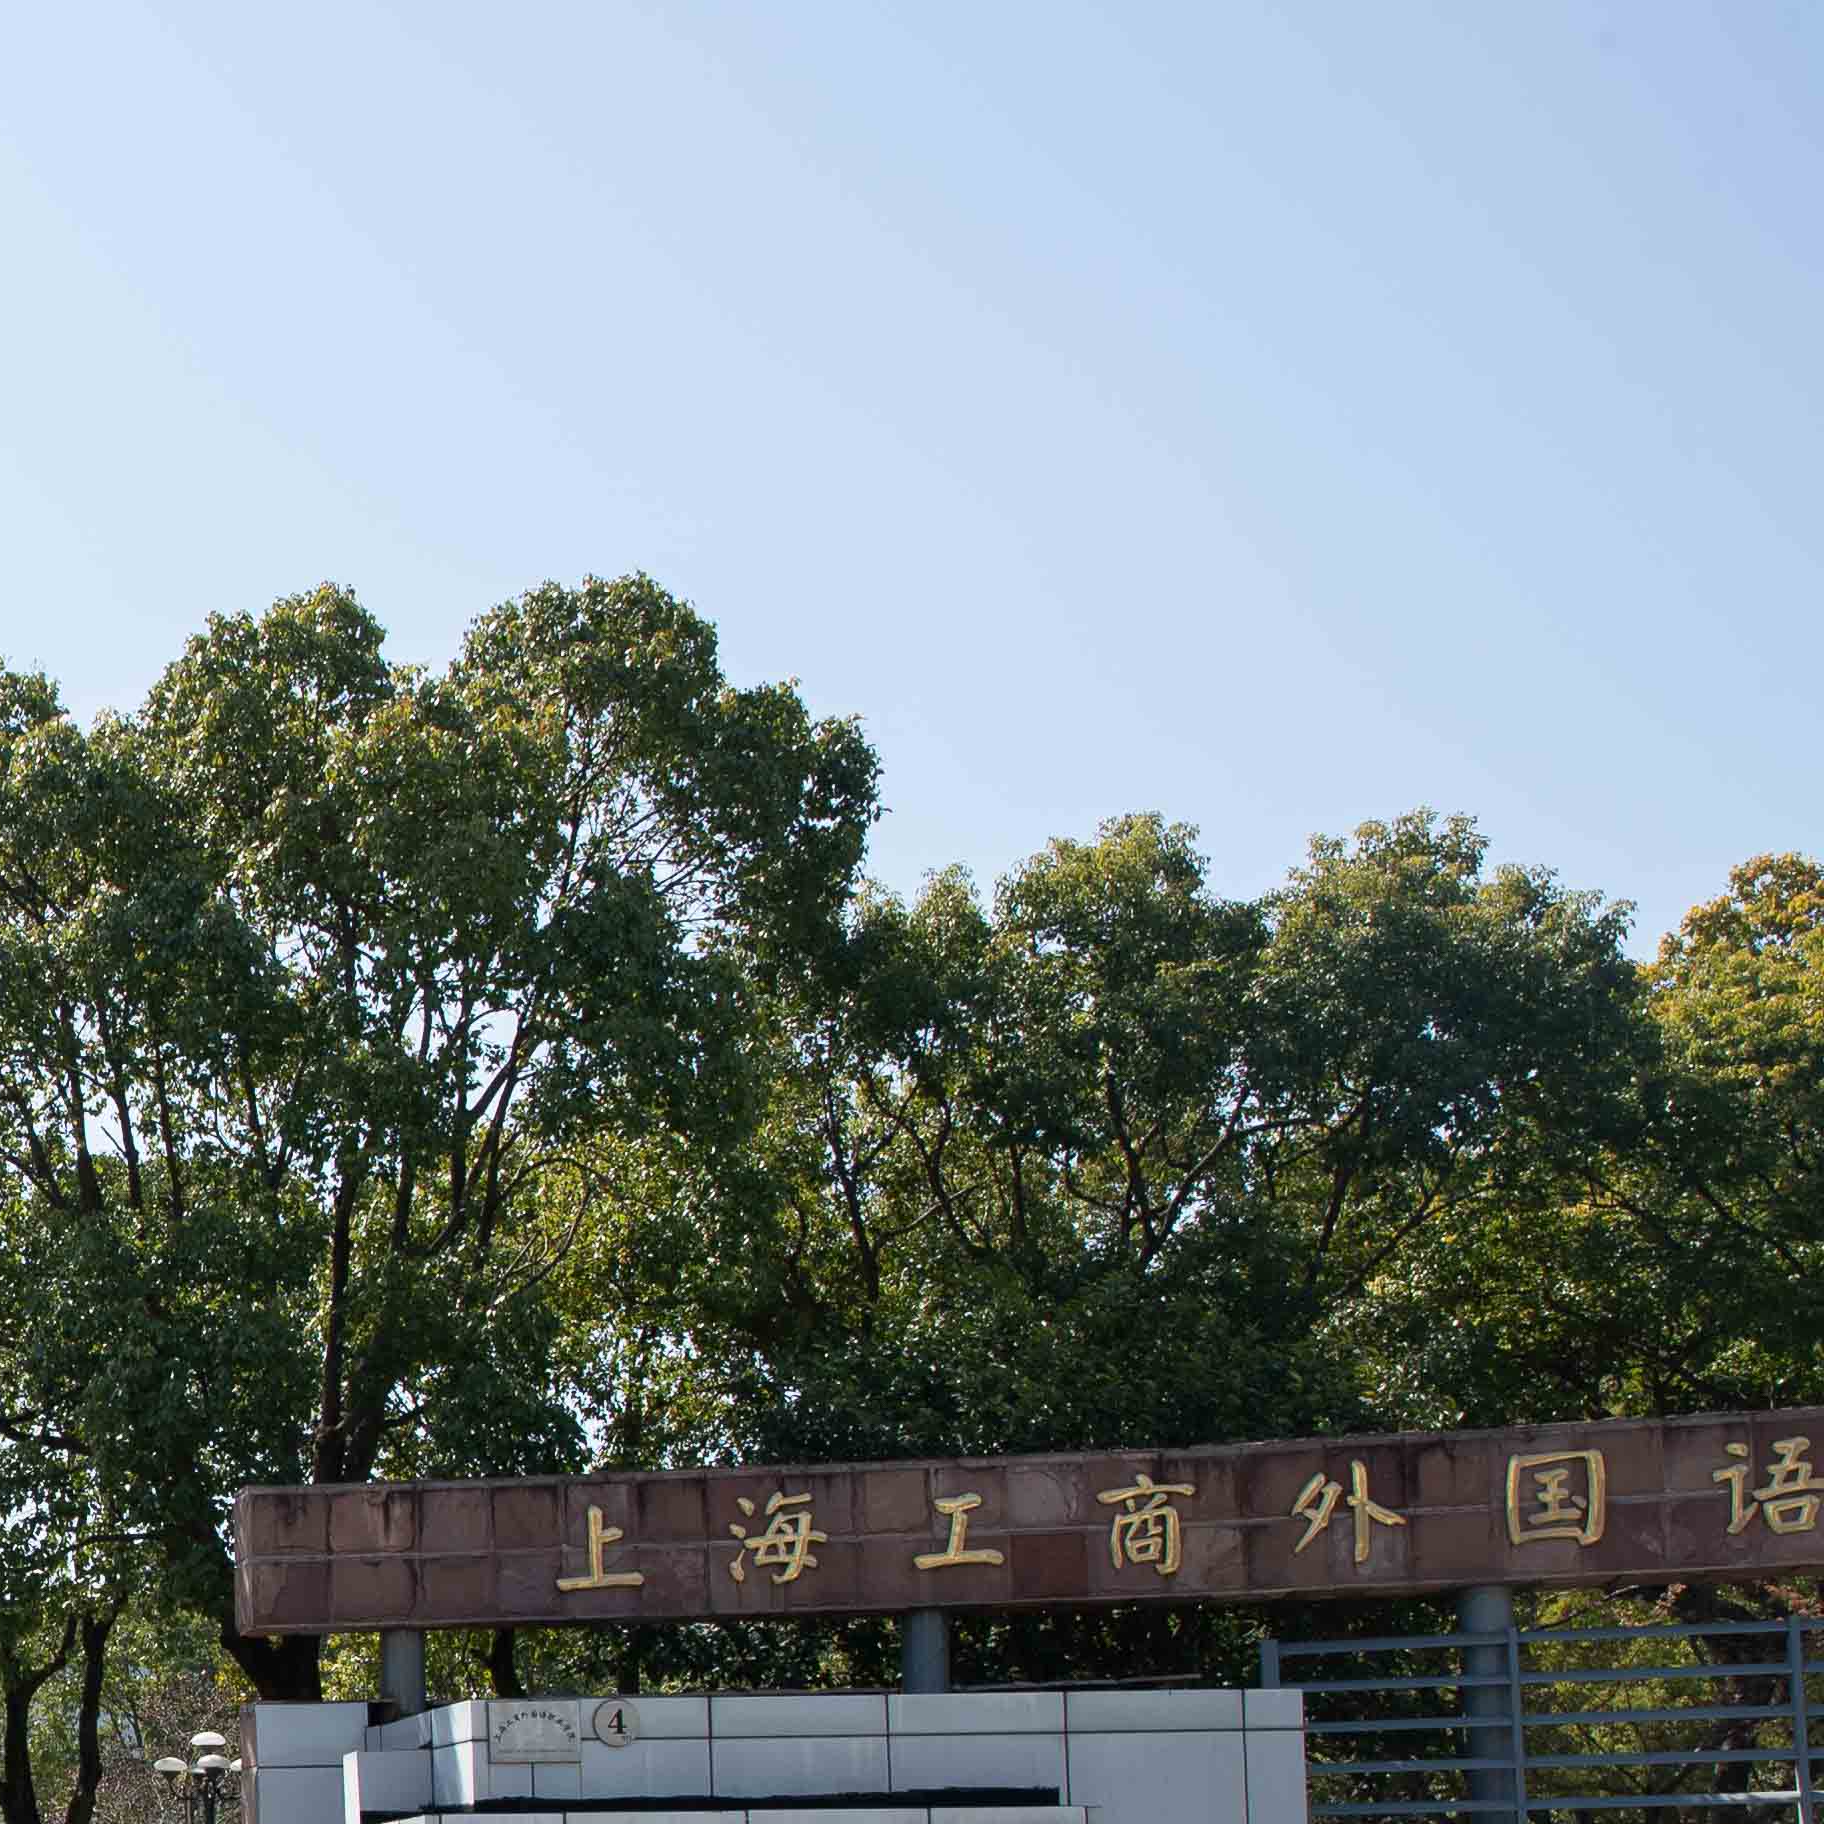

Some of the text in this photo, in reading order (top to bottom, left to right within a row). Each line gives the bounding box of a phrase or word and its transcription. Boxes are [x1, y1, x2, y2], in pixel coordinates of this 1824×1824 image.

[555, 1435, 1824, 1591] 上海工商外国语
[607, 1707, 627, 1735] 4
